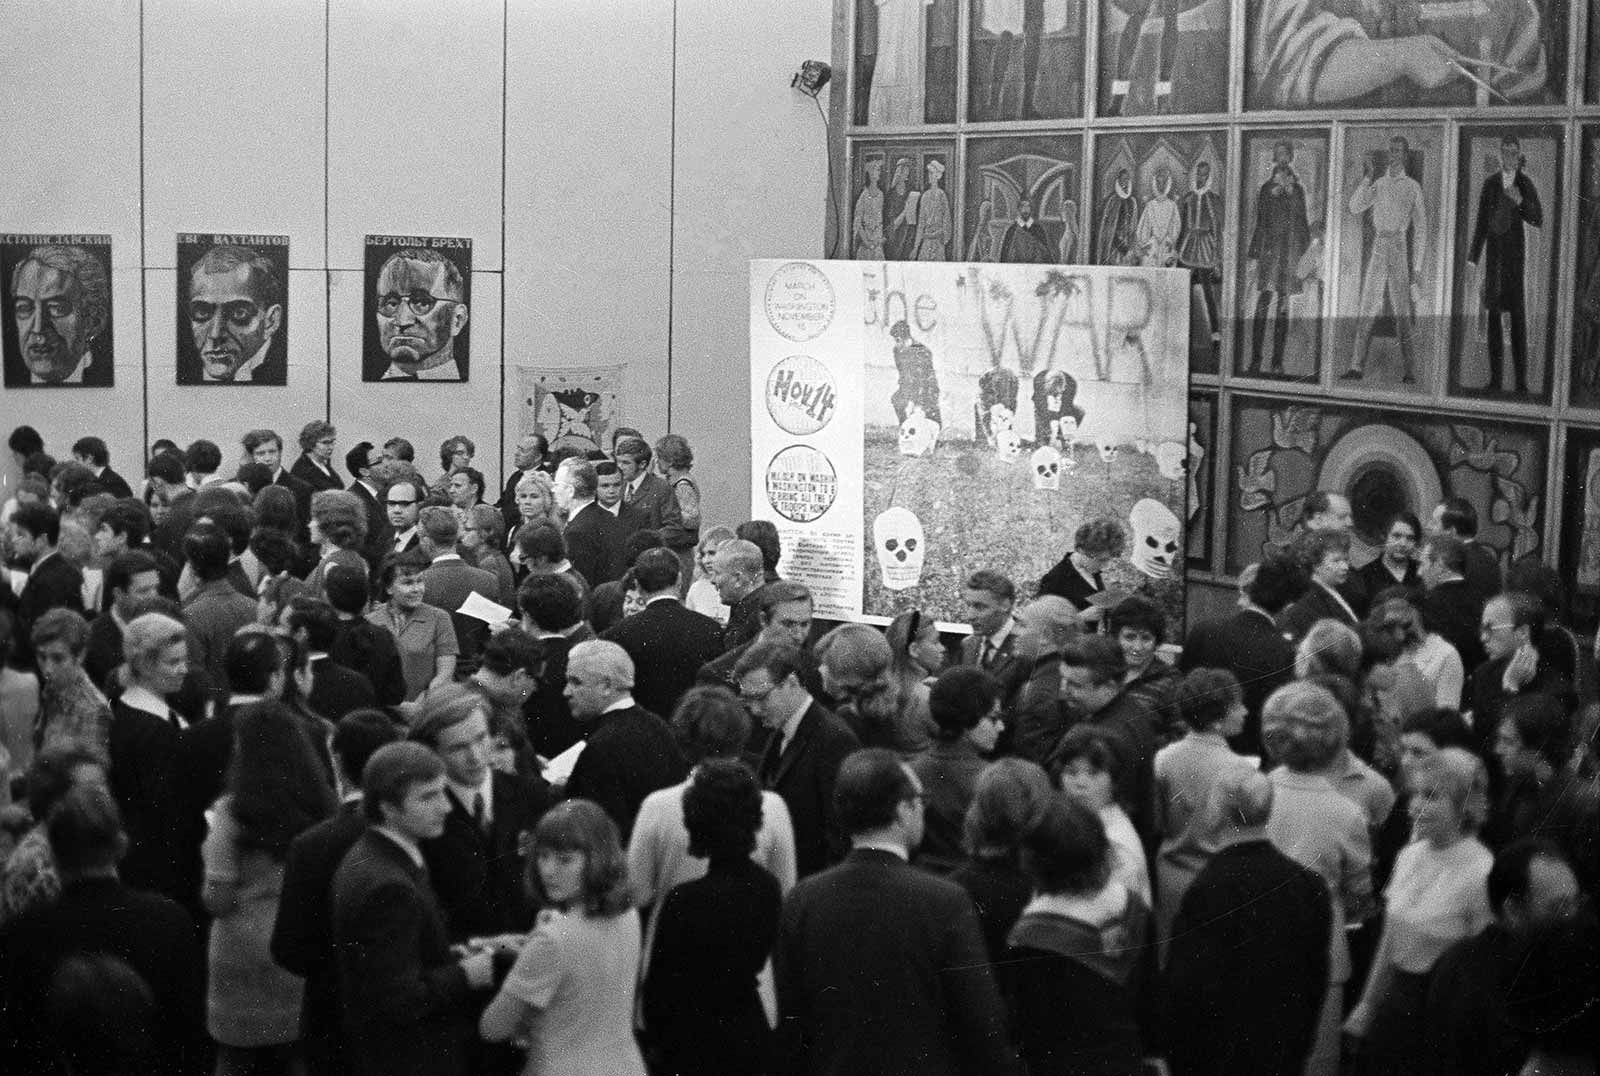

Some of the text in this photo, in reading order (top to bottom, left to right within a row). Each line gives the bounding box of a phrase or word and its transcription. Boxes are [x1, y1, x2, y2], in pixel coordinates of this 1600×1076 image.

[431, 238, 472, 249] БРЕХТ
[778, 312, 824, 321] NOVEMBER
[968, 267, 1152, 385] WAR
[772, 482, 816, 492] WASHINGTON
[801, 493, 811, 502] ALL
[814, 494, 825, 503] THE
[781, 501, 807, 512] TROOPS
